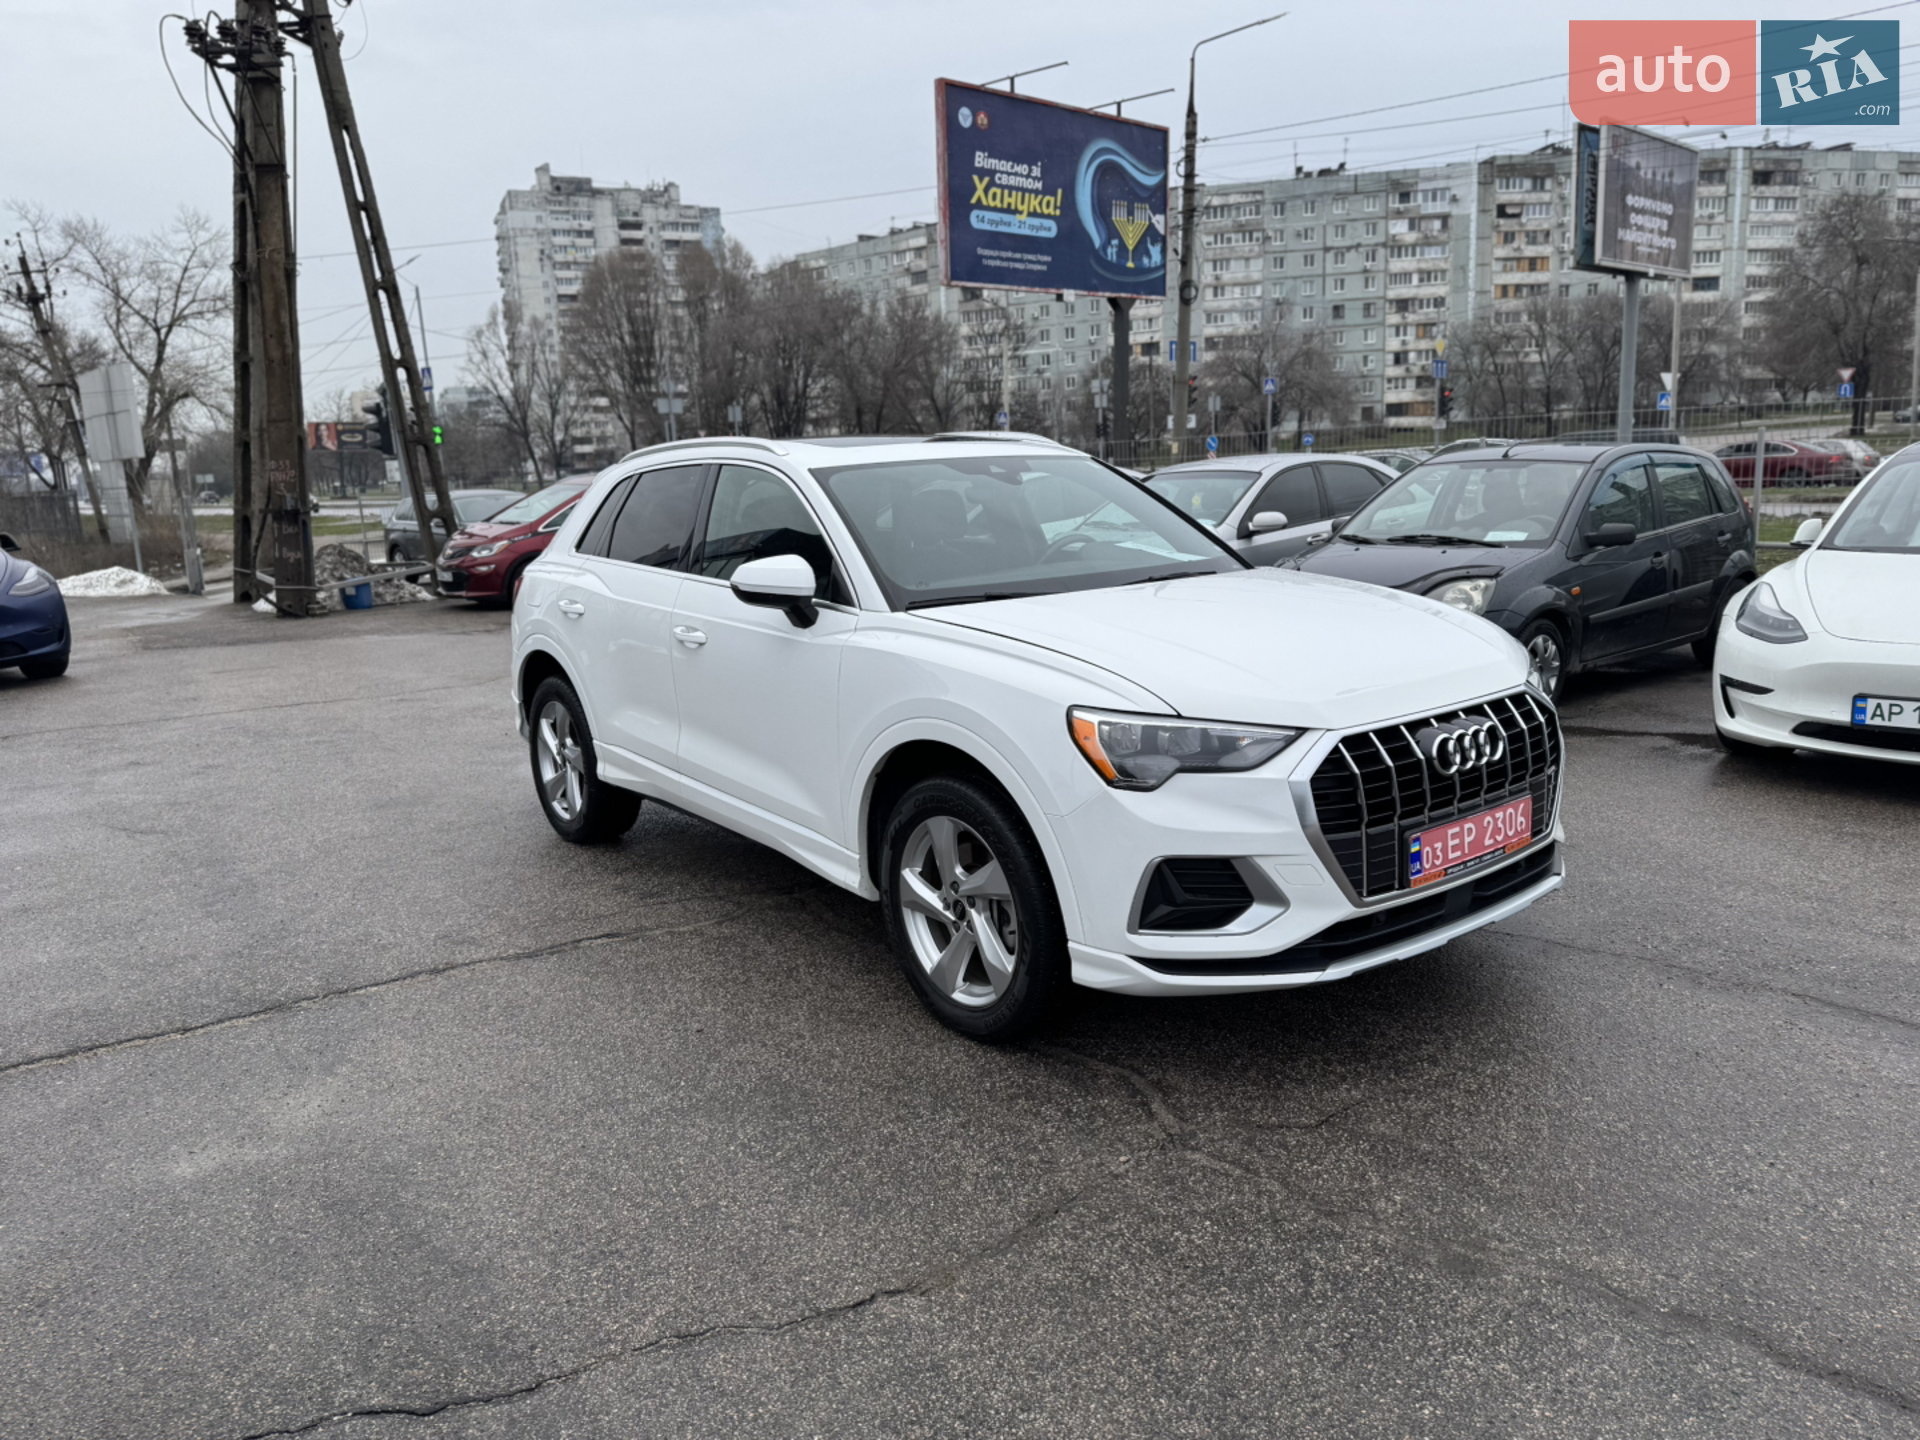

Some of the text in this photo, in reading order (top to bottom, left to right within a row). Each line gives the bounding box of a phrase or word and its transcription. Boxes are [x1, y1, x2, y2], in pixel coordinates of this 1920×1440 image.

[974, 150, 1042, 178] Вітаємо зі
[994, 172, 1043, 191] святом
[970, 174, 1063, 219] Ханука!
[975, 213, 985, 224] 14
[986, 216, 1012, 229] грудня
[1017, 220, 1026, 229] 21
[1027, 223, 1052, 235] грудня
[1870, 702, 1904, 722] AP
[1423, 842, 1443, 869] 03
[1447, 823, 1476, 860] EP
[1483, 803, 1526, 847] 2306
[1411, 861, 1421, 872] UA
